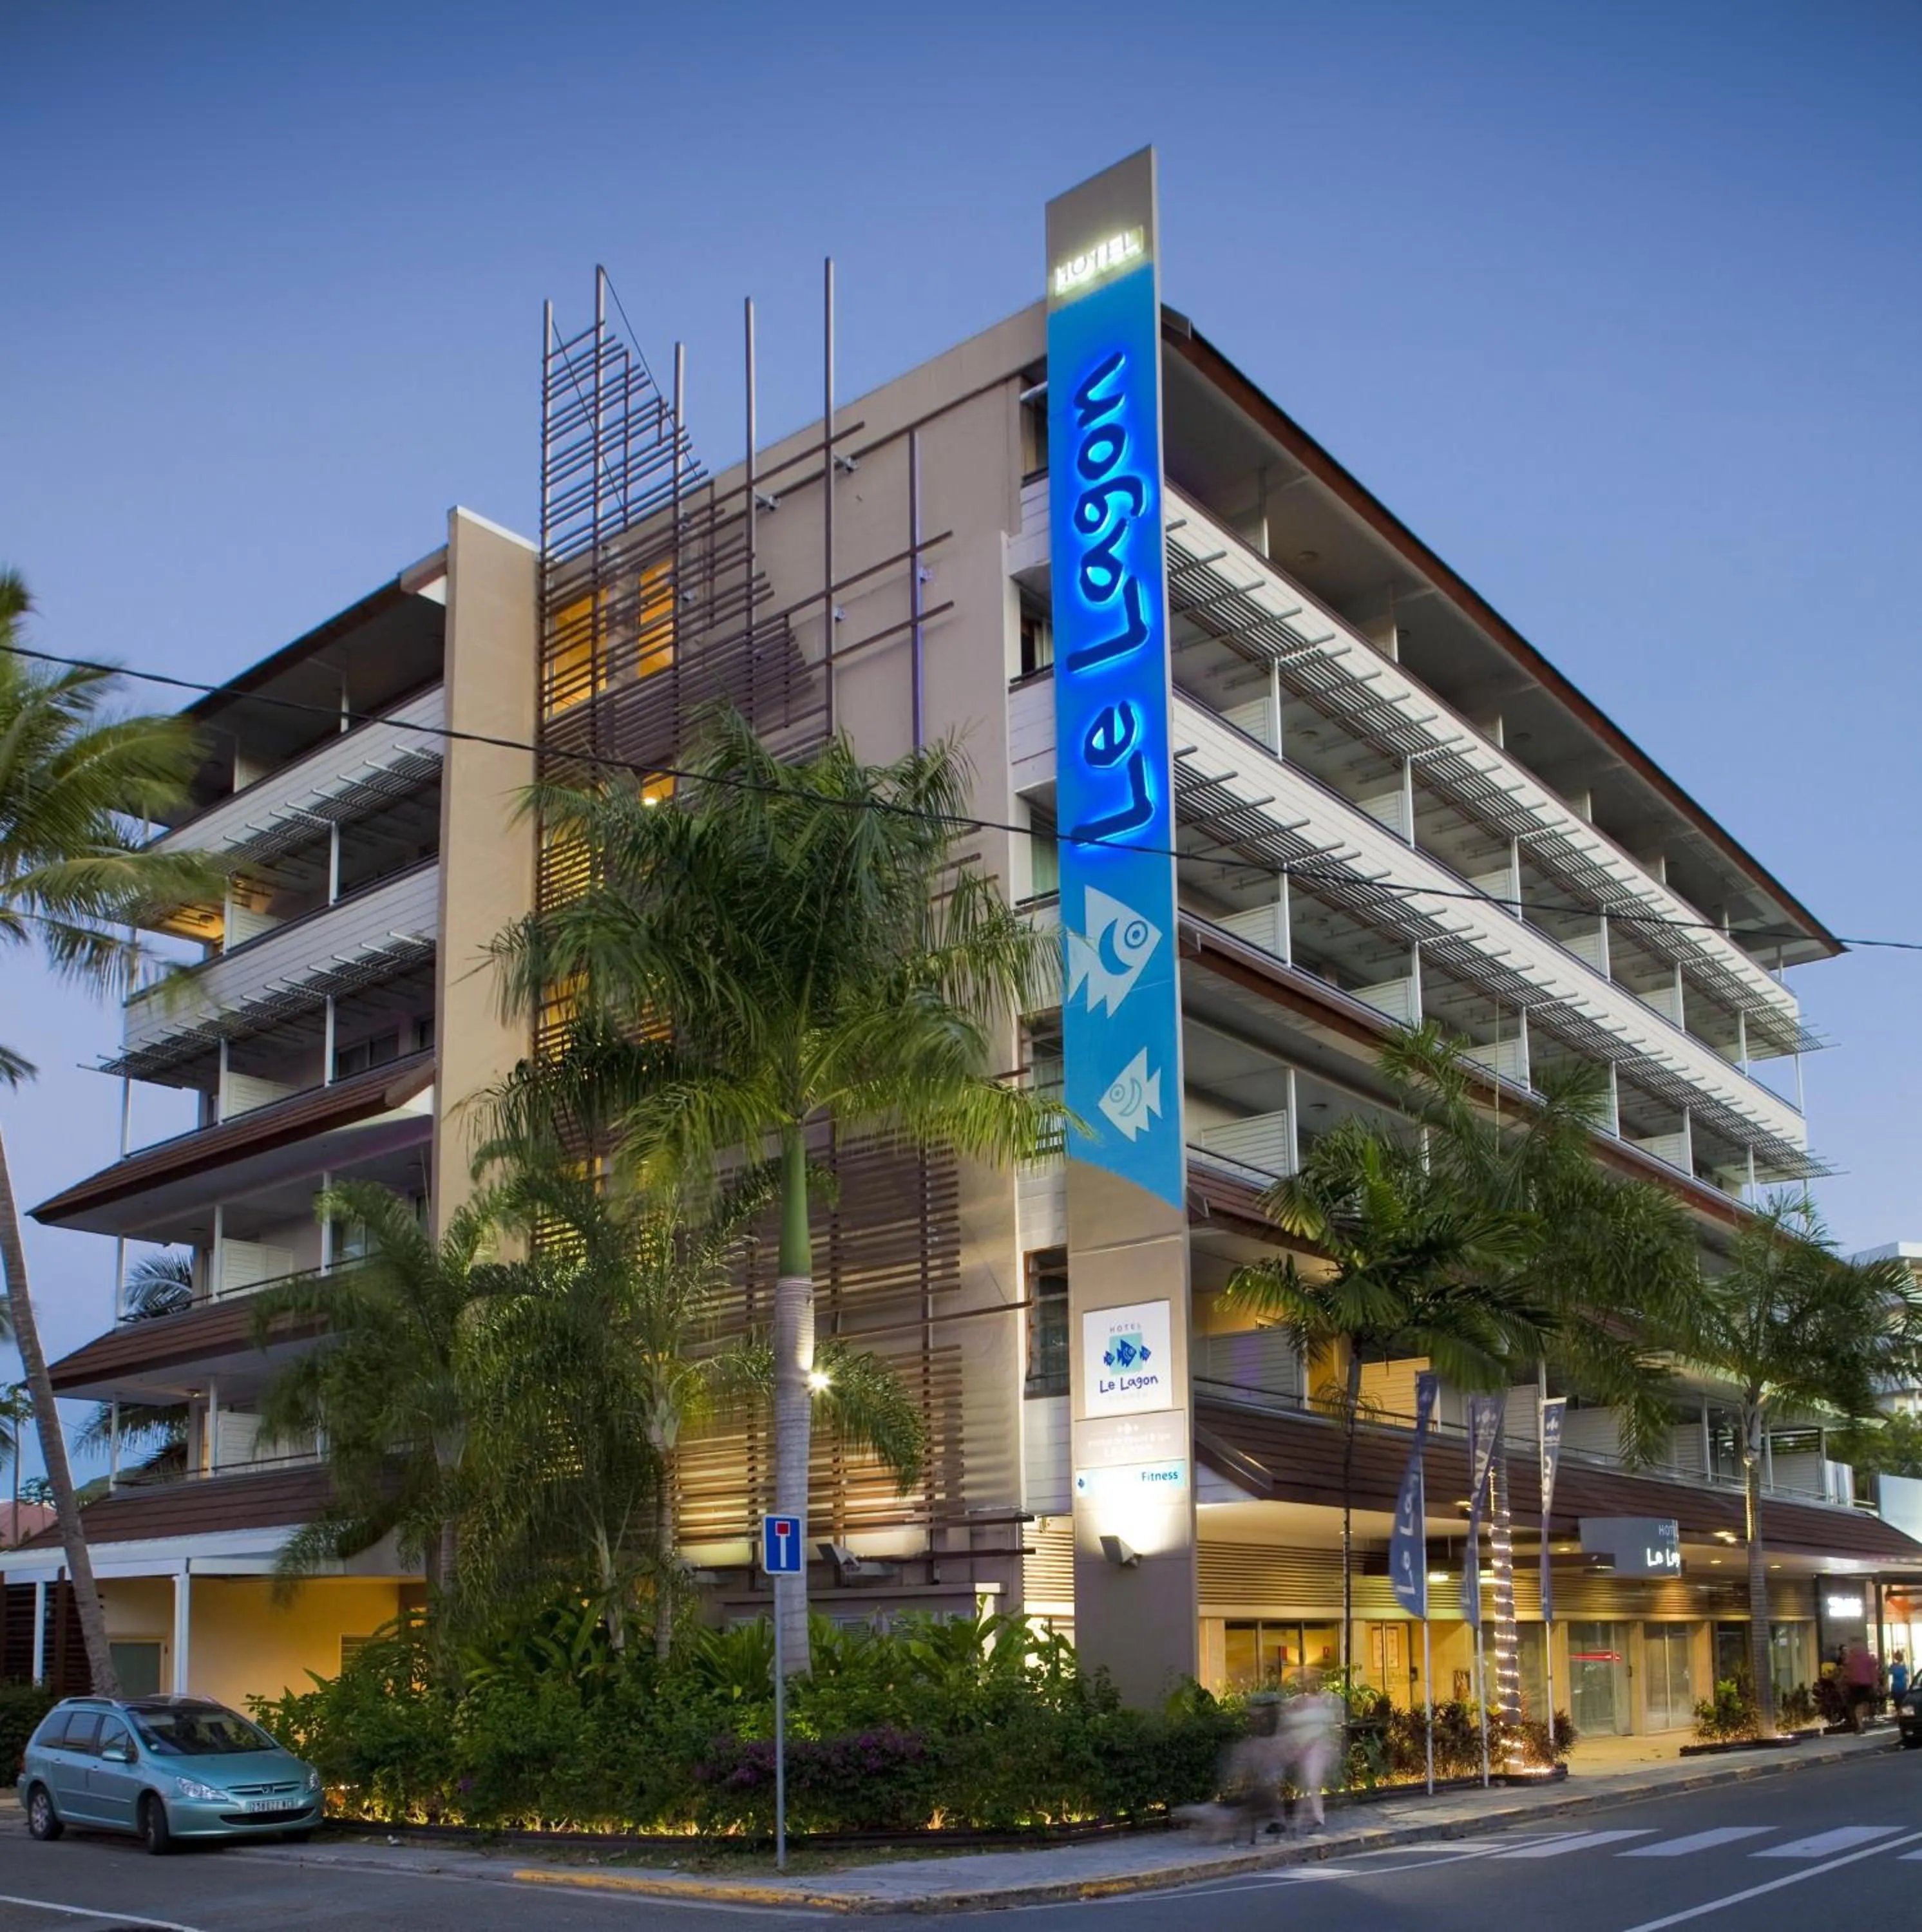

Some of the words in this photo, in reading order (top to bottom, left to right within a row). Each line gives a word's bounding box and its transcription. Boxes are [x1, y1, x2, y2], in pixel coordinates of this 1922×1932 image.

[1054, 225, 1145, 296] HOTEL
[1066, 350, 1150, 674] Lagon
[1070, 698, 1154, 849] Le
[1110, 1322, 1141, 1333] HOTEL
[1099, 1380, 1116, 1394] Le
[1120, 1375, 1159, 1391] Lagon
[1141, 1471, 1179, 1482] Fitness
